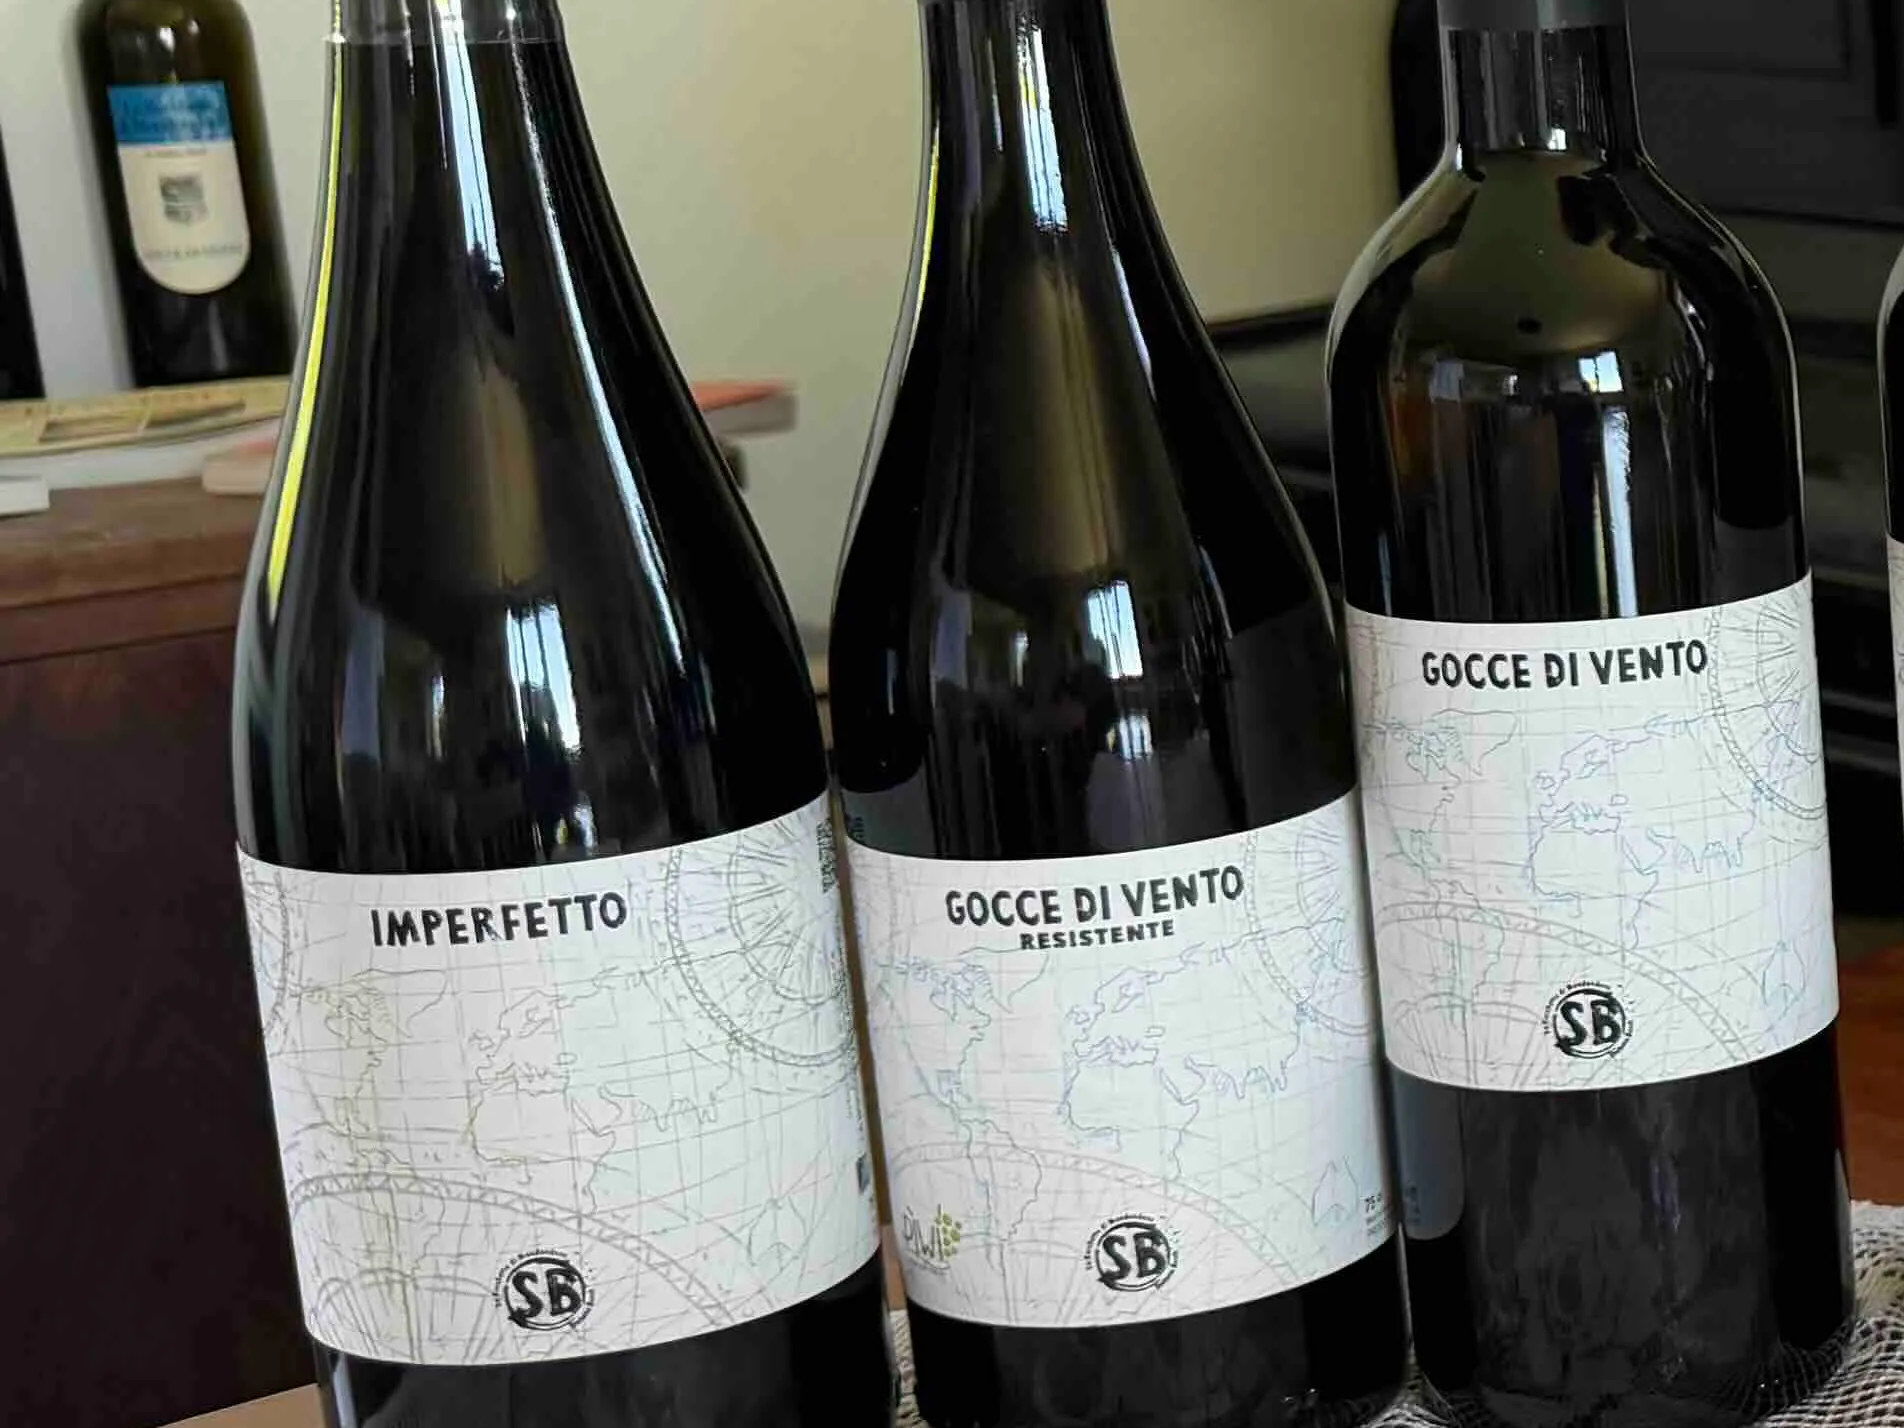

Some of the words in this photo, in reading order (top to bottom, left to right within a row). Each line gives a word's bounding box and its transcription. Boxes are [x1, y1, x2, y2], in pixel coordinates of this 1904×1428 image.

[1421, 650, 1532, 690] GOCCE
[1544, 650, 1580, 689] DI
[1589, 638, 1709, 685] VENTO
[370, 890, 629, 949] IMPERFETTO
[944, 887, 1062, 929] GOCCE
[1074, 886, 1111, 922] DI
[1126, 864, 1245, 918] VENTO
[1019, 919, 1175, 951] RESISTENTE
[1560, 999, 1622, 1046] SB
[1101, 1231, 1167, 1279] SB
[511, 1267, 582, 1319] SB
